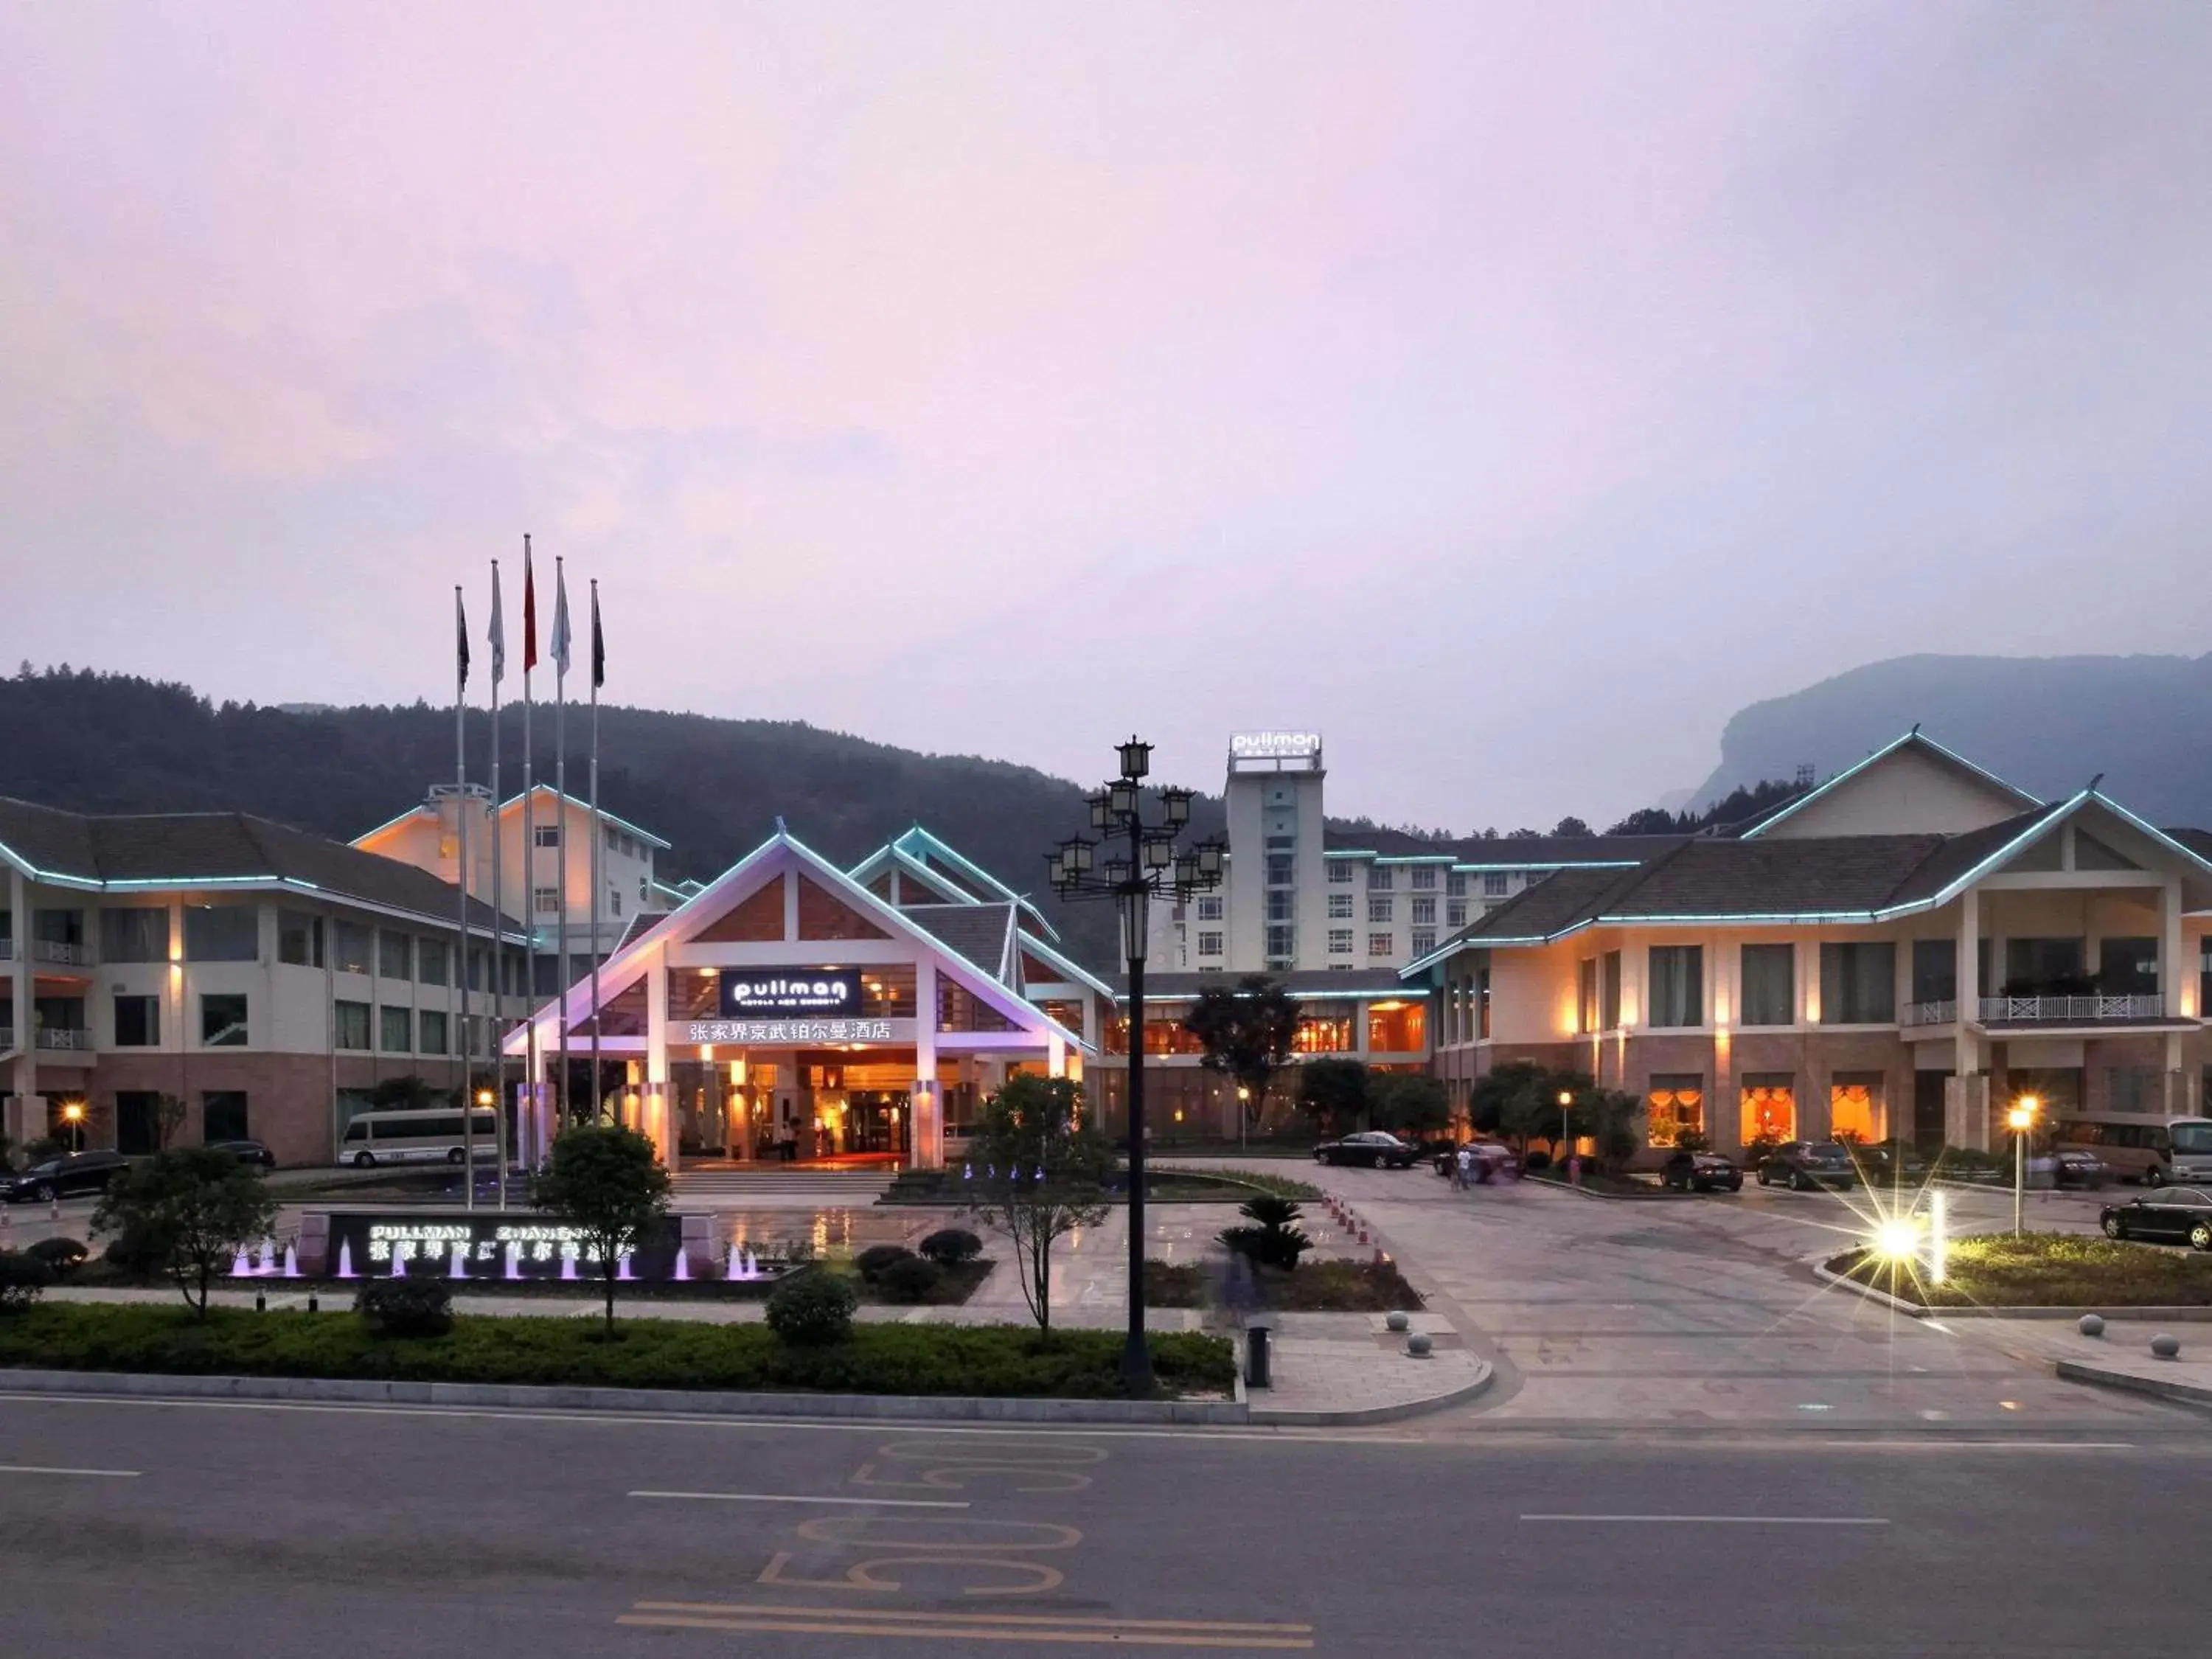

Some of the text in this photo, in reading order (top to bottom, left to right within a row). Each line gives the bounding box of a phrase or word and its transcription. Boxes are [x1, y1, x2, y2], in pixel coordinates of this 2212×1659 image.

[1234, 731, 1319, 751] pullman
[734, 980, 847, 1001] pullman
[689, 1021, 891, 1040] 张家界京武铂尔曼酒店
[369, 1225, 471, 1240] PULLMAN
